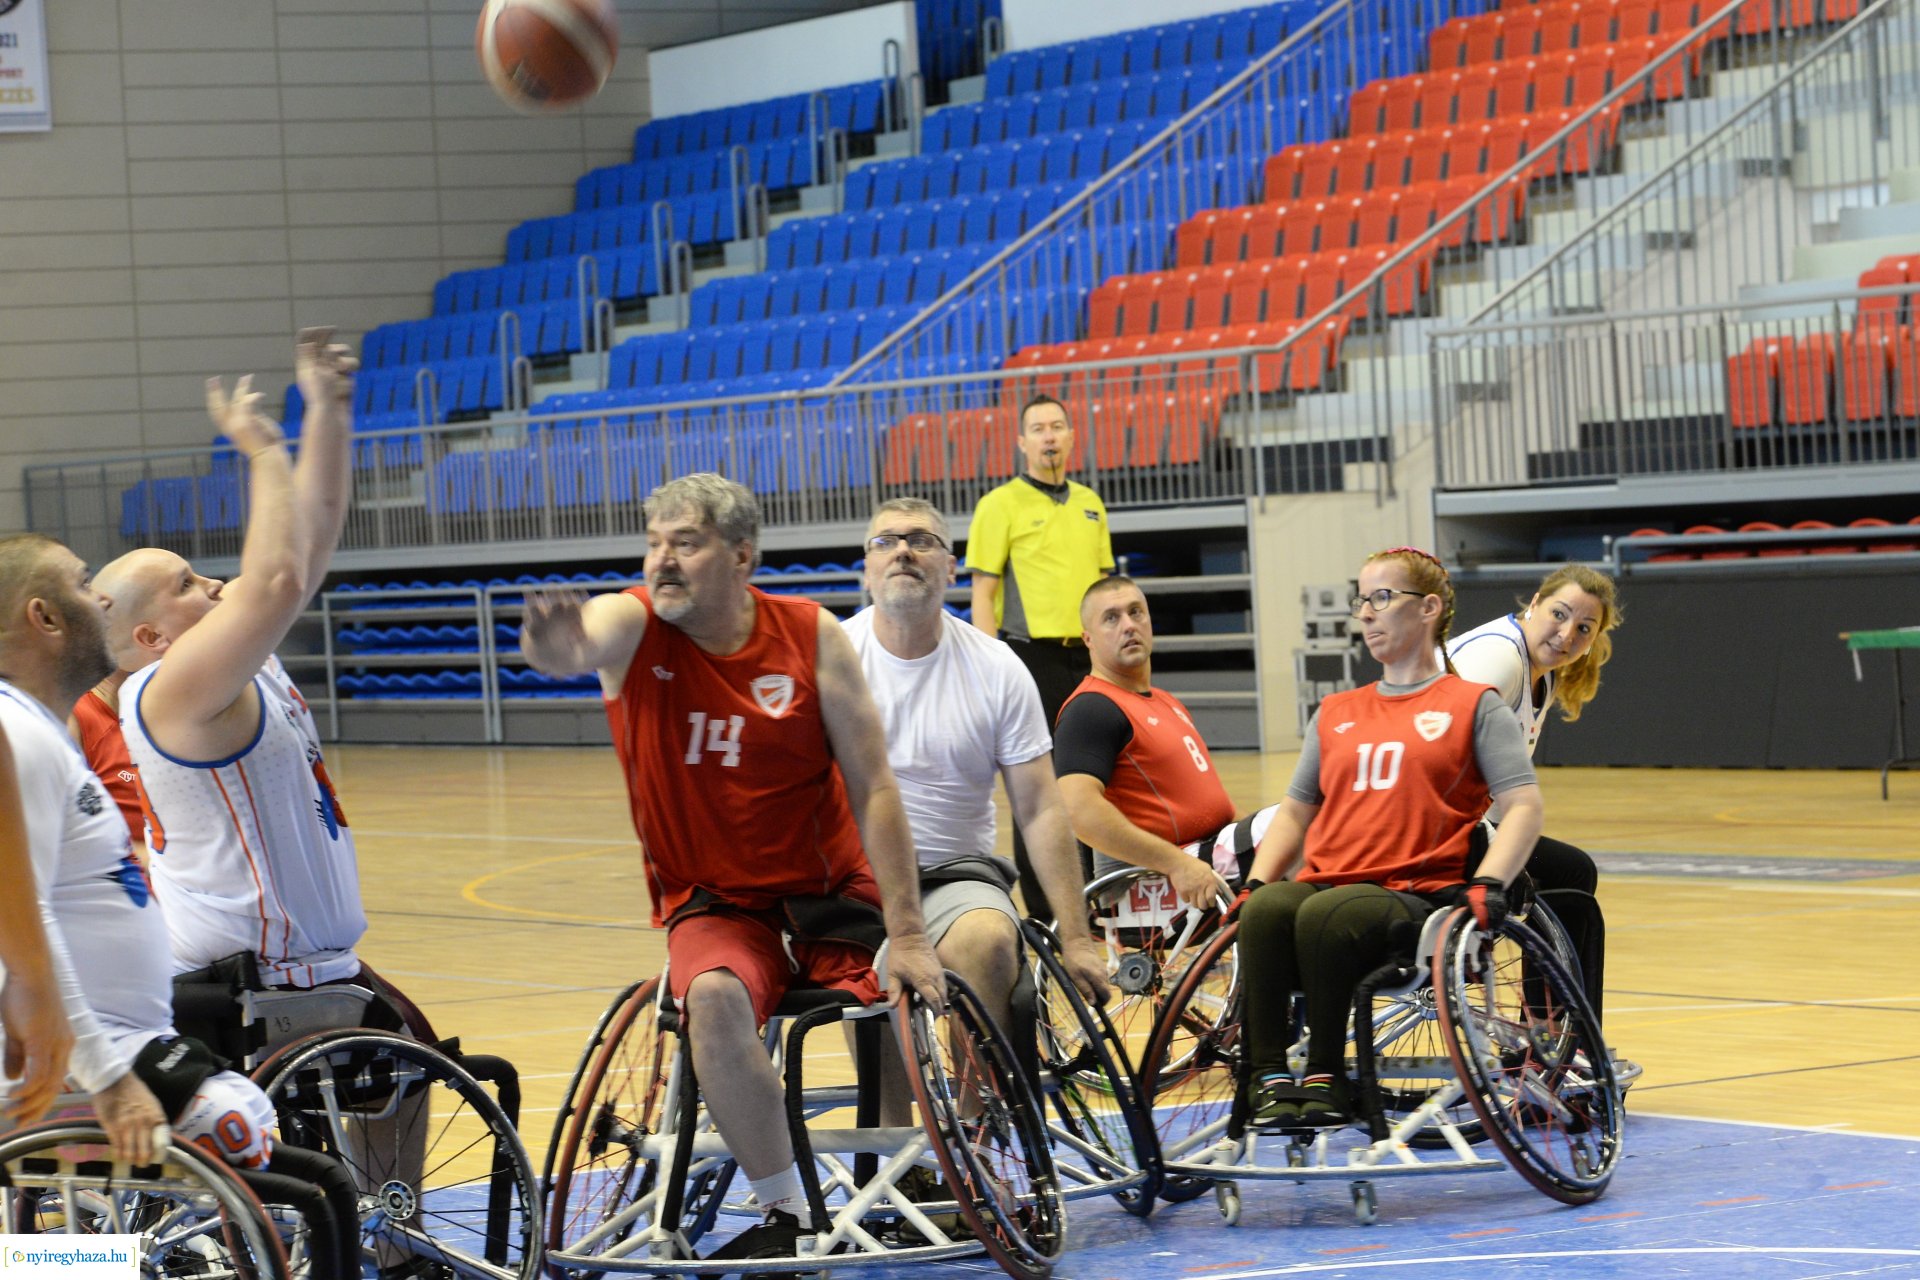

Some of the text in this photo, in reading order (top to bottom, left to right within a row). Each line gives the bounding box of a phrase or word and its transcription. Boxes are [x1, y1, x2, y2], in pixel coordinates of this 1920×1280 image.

[684, 711, 746, 767] 14
[1182, 735, 1209, 772] 8
[1352, 741, 1405, 791] 10
